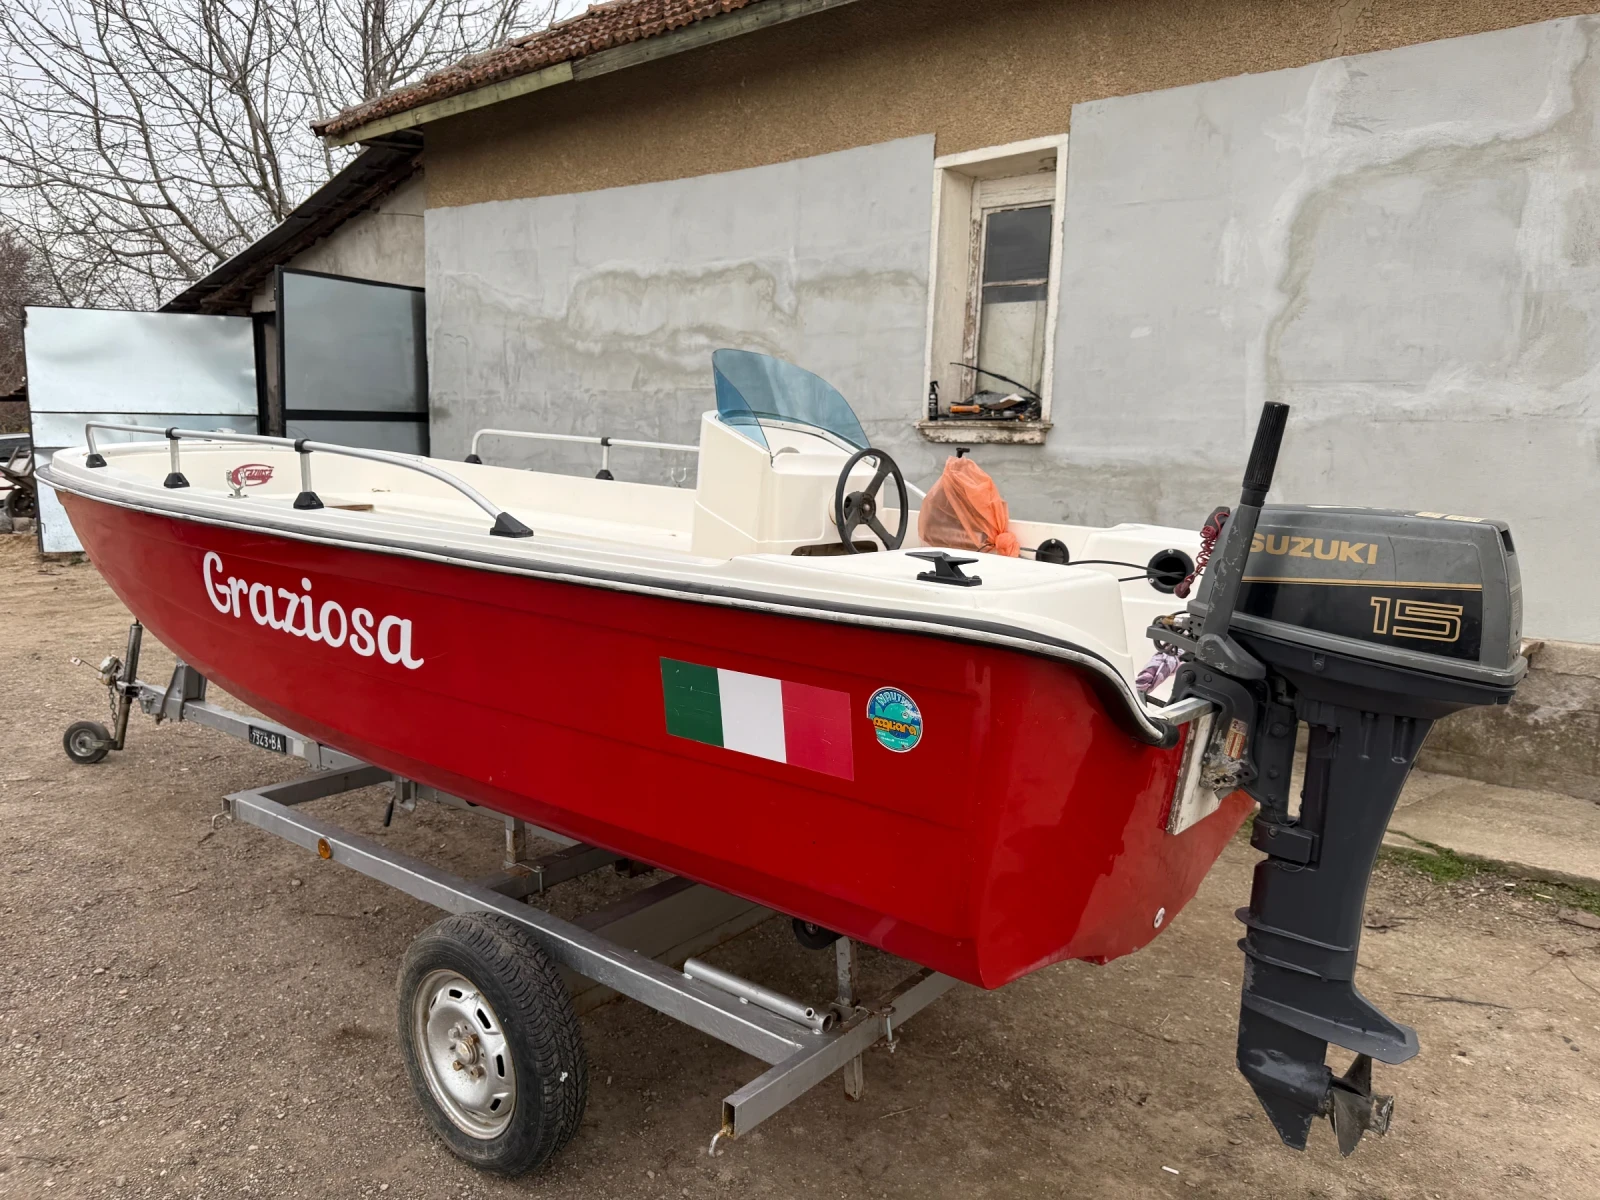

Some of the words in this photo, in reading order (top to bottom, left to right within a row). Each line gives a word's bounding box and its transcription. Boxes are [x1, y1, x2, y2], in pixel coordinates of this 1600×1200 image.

[1249, 532, 1378, 565] SUZUKI
[202, 551, 425, 670] Graziosa
[1370, 596, 1464, 643] 15
